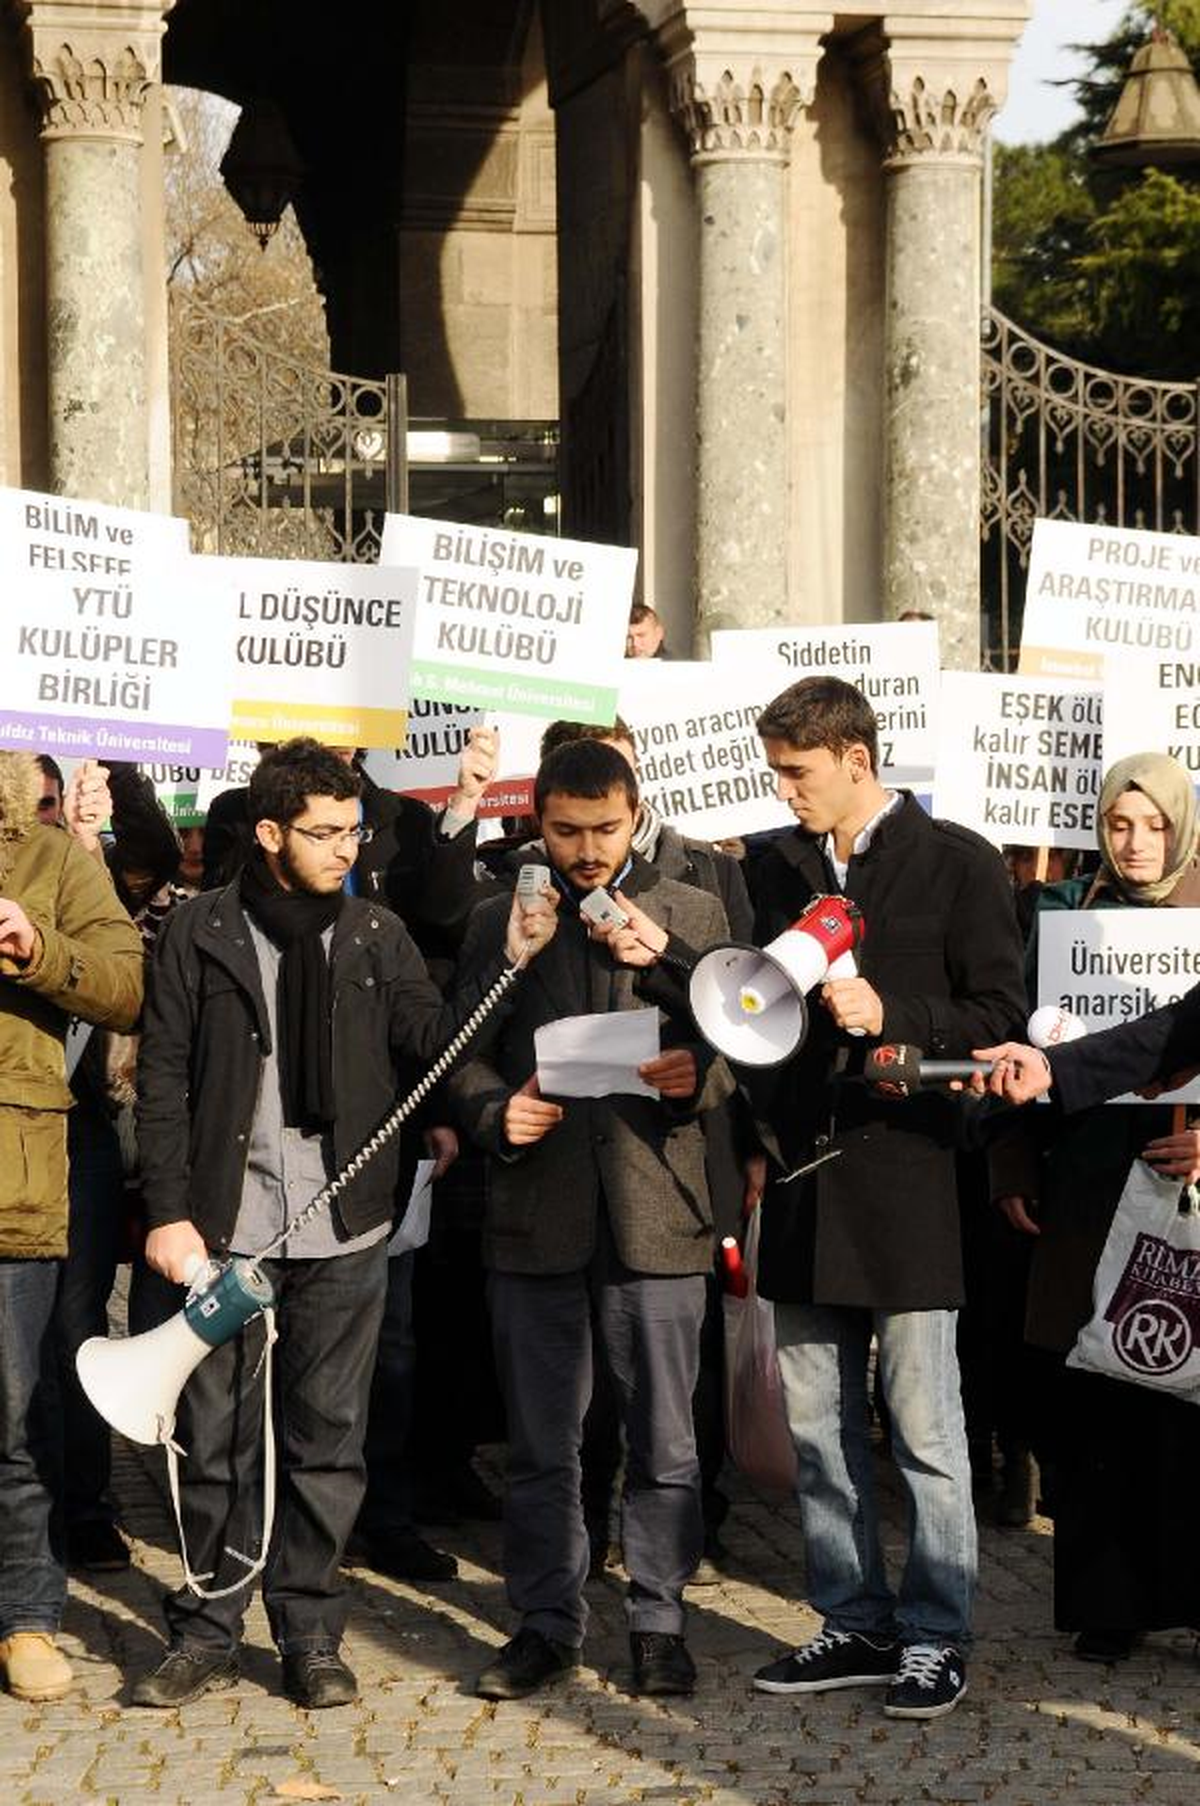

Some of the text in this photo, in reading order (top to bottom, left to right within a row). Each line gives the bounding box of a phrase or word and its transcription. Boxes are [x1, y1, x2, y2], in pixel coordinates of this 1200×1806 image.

[25, 501, 133, 545] BİLİM ve
[432, 529, 584, 581] BİLİŞİM ve
[1088, 538, 1171, 570] PROJE
[73, 583, 133, 619] YTÜ
[239, 587, 401, 630] L DÜŞÜNCE
[423, 575, 584, 625] TEKNOLOJİ
[1038, 571, 1197, 612] ARAŞTIRMA
[18, 625, 178, 668] KULÜPLER
[438, 621, 557, 665] KULÜBÜ
[1086, 616, 1193, 651] KULÜBÜ
[38, 668, 152, 711] BİRLİĞİ
[854, 673, 919, 697] duran
[1159, 663, 1200, 688] EN
[1001, 692, 1064, 725] EŞEK
[37, 725, 93, 746] Teknik
[97, 727, 192, 754] Üniversitesi
[629, 703, 770, 754] yon aracım
[973, 725, 1030, 755] kalır
[702, 736, 760, 771] değil
[882, 742, 895, 767] Z
[986, 756, 1102, 796] İNSAN öl
[985, 798, 1040, 826] kalır
[1072, 941, 1200, 975] Üniversite
[1124, 1312, 1183, 1366] RK
